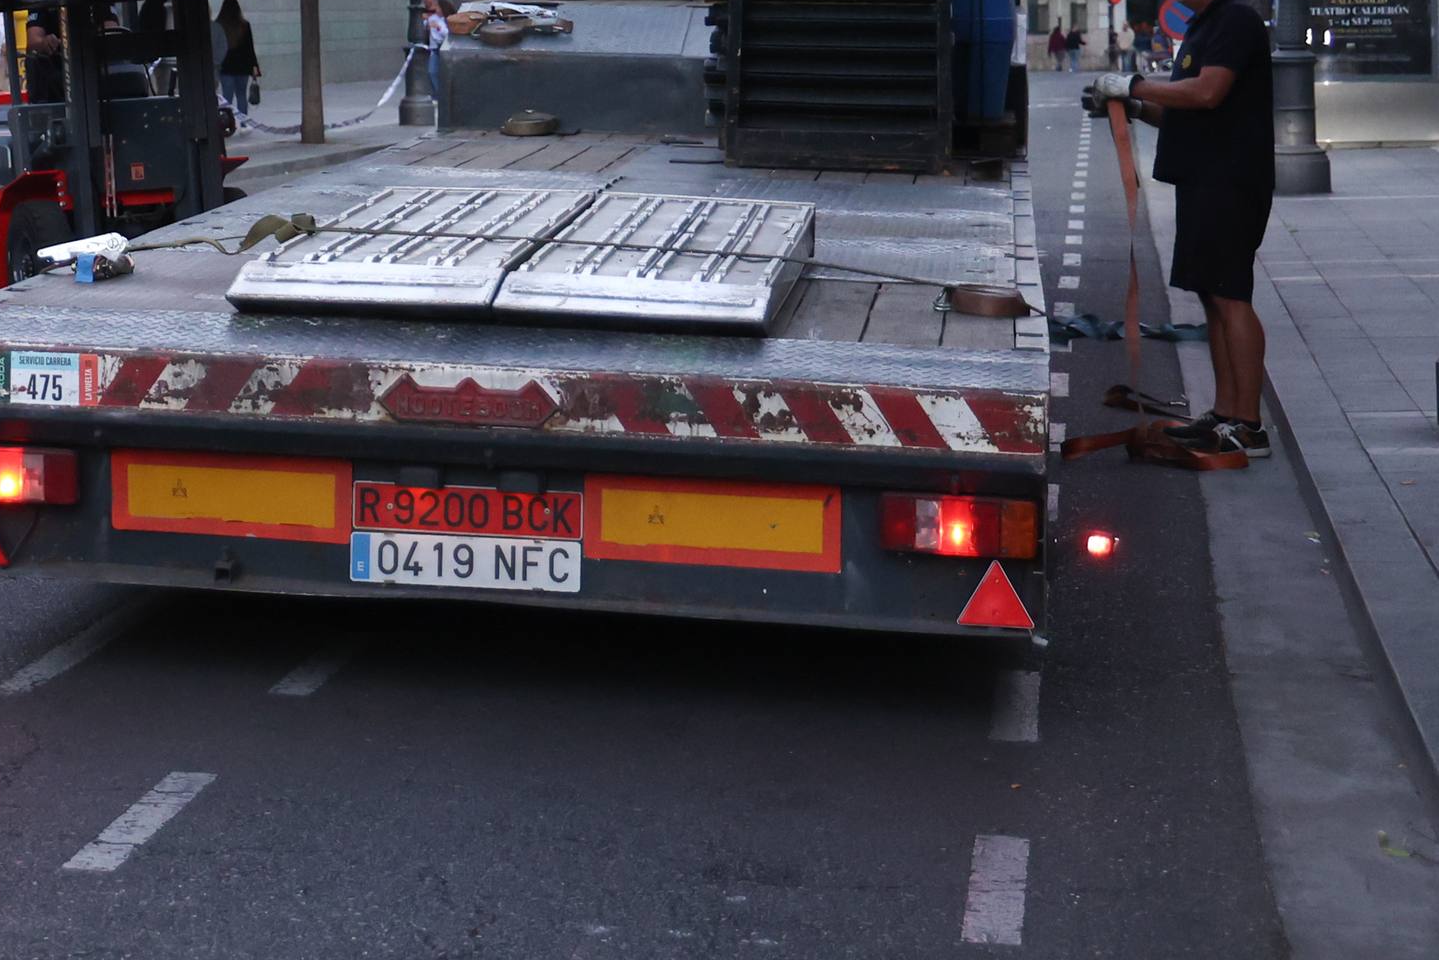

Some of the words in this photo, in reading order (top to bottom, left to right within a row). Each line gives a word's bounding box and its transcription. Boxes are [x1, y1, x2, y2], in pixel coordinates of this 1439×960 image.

[1310, 6, 1350, 16] TEATRO
[1352, 4, 1410, 15] CALDERÓN
[19, 355, 44, 365] SERVICIO
[45, 357, 72, 366] CARRERA
[27, 373, 62, 401] 475
[359, 487, 381, 523] R
[394, 489, 490, 529] 9200
[503, 494, 574, 534] BCK
[357, 561, 365, 572] E
[378, 539, 475, 579] 0419
[494, 544, 570, 584] NFC
